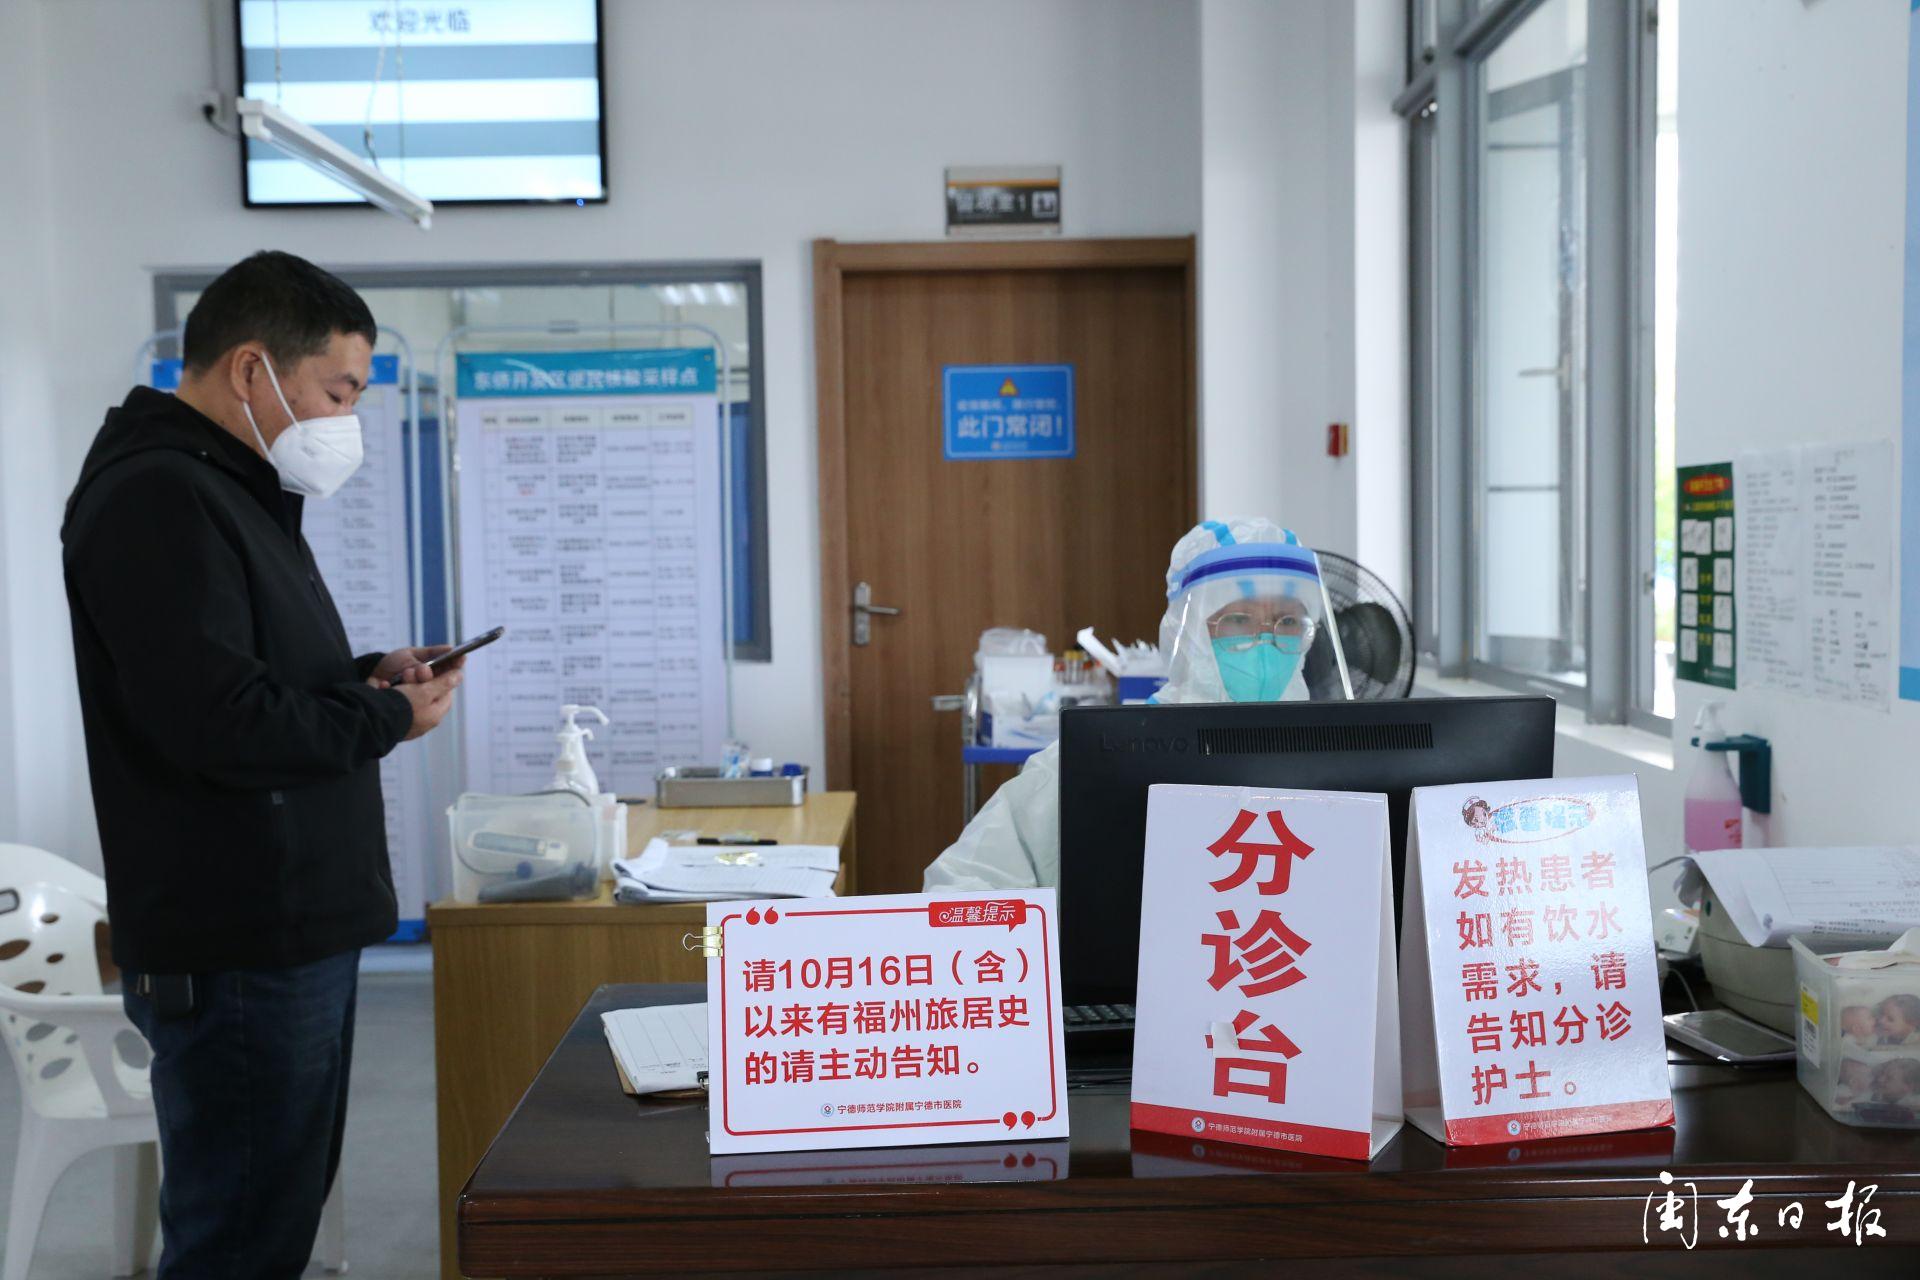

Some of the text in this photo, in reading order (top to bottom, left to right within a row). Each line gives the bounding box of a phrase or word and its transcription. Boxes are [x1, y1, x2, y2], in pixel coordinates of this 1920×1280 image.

[1452, 850, 1616, 899] 发热患者
[939, 902, 1016, 923] 温馨提示
[1457, 901, 1624, 951] 如有饮水
[742, 948, 1029, 993] 请10月16日（含）
[1201, 809, 1315, 1104] 分诊台
[1461, 951, 1627, 1002] 需求，请
[744, 995, 1030, 1038] 以来有福州旅居史
[1467, 1000, 1632, 1054] 告知分诊
[745, 1044, 979, 1085] 的请主动告知。
[1472, 1060, 1577, 1106] 护士。
[837, 1100, 962, 1114] 宁德师范学院附属宁德市医院
[1209, 1122, 1303, 1143] 宁德师范学院附属宁德市医院
